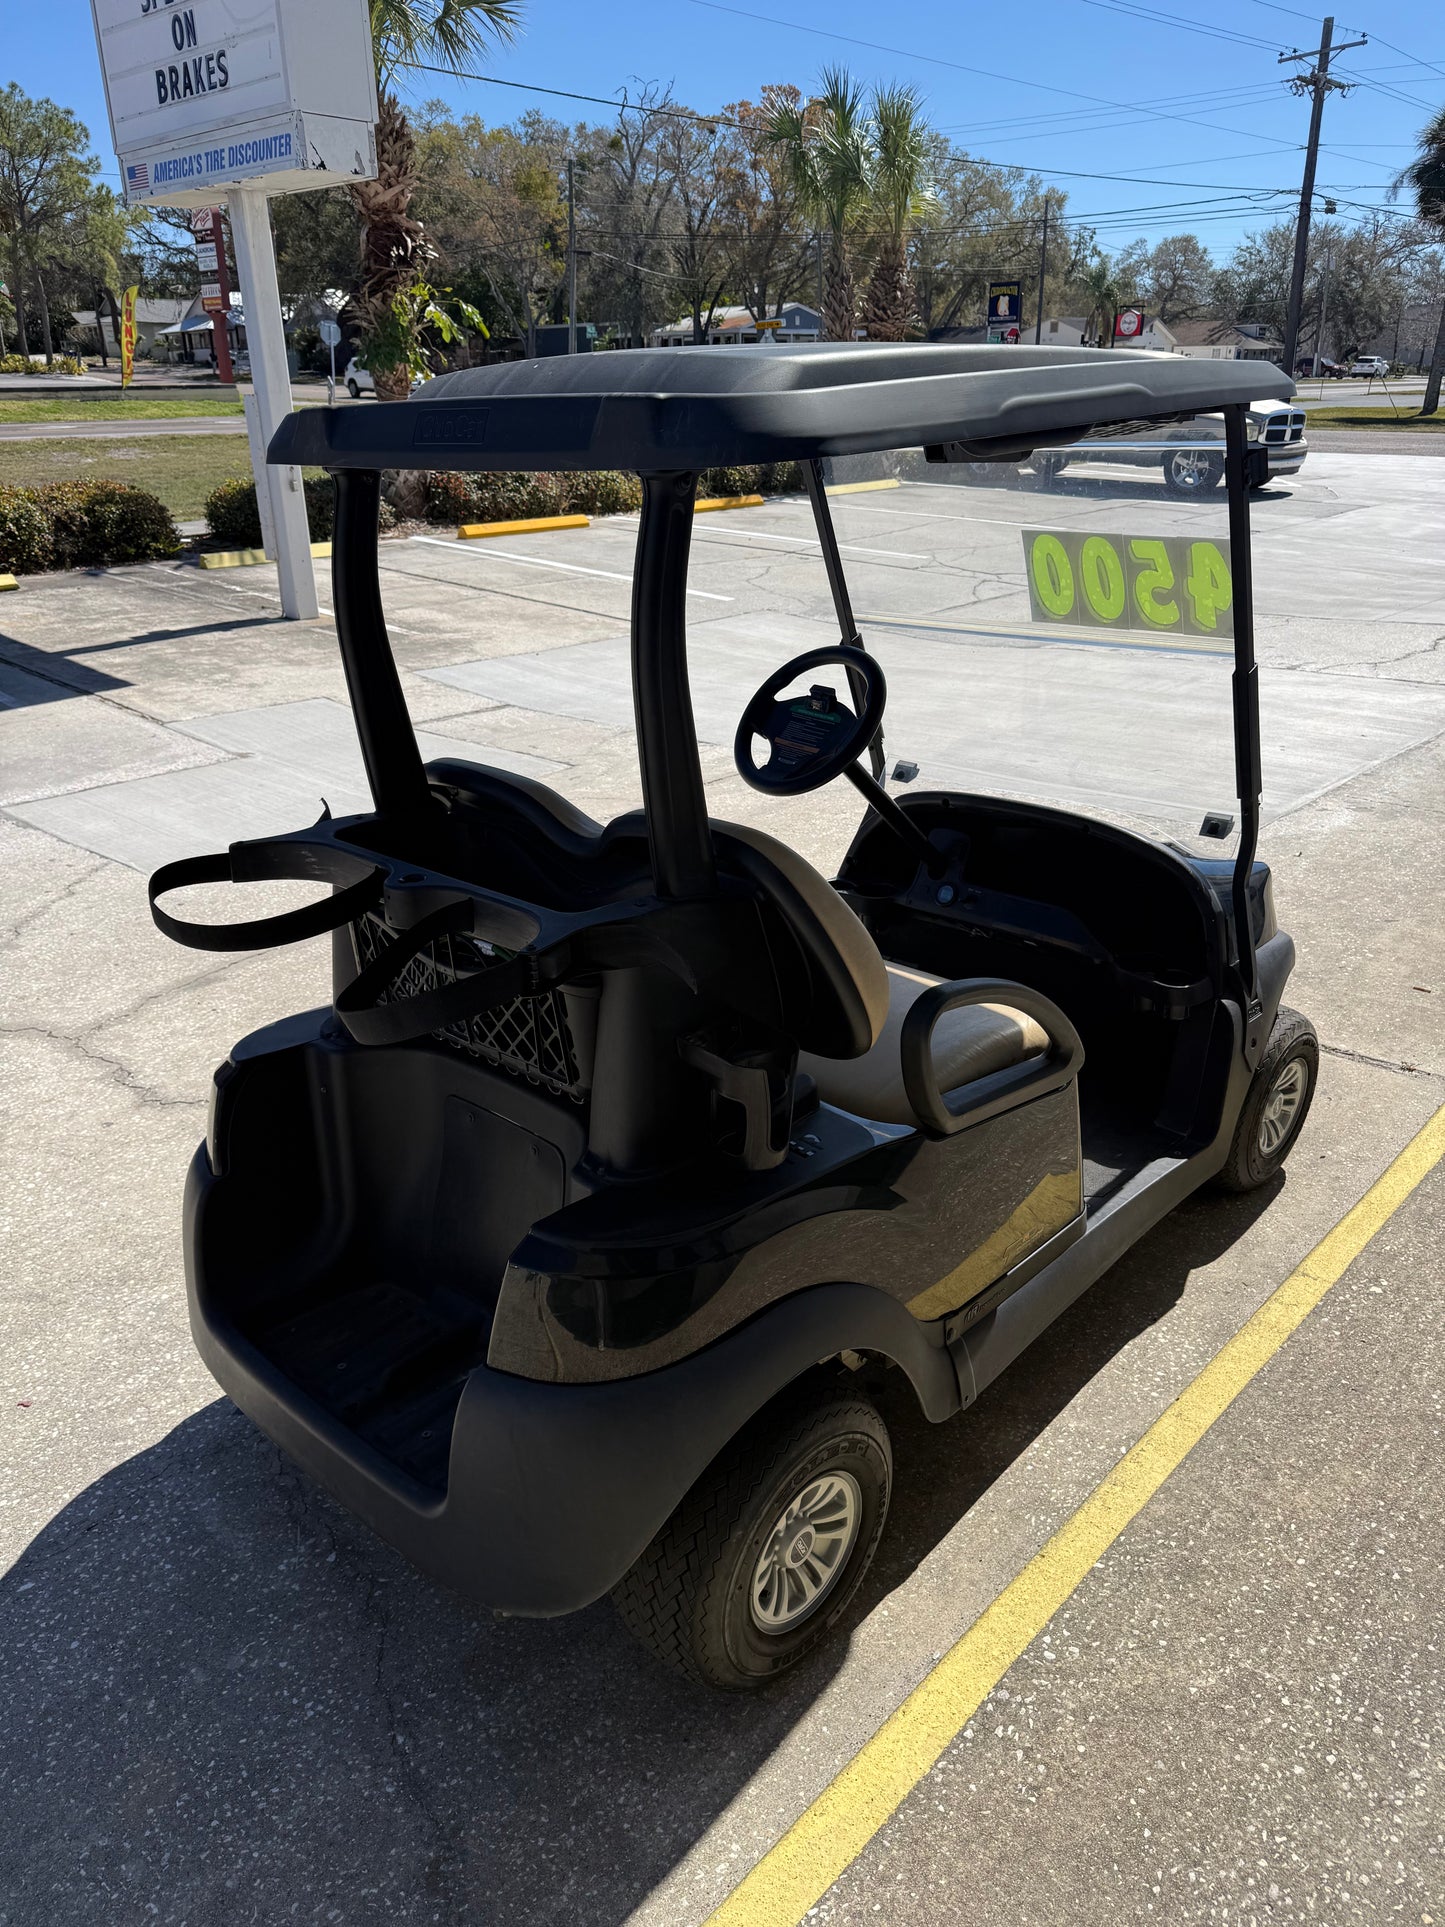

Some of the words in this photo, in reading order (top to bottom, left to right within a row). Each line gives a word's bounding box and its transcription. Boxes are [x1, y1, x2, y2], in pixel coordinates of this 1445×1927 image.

[171, 9, 197, 51] ON
[155, 49, 229, 104] BRAKES
[153, 154, 203, 184] AMERICA'S
[204, 148, 226, 173] TIRE
[228, 133, 292, 168] DISCOUNTER
